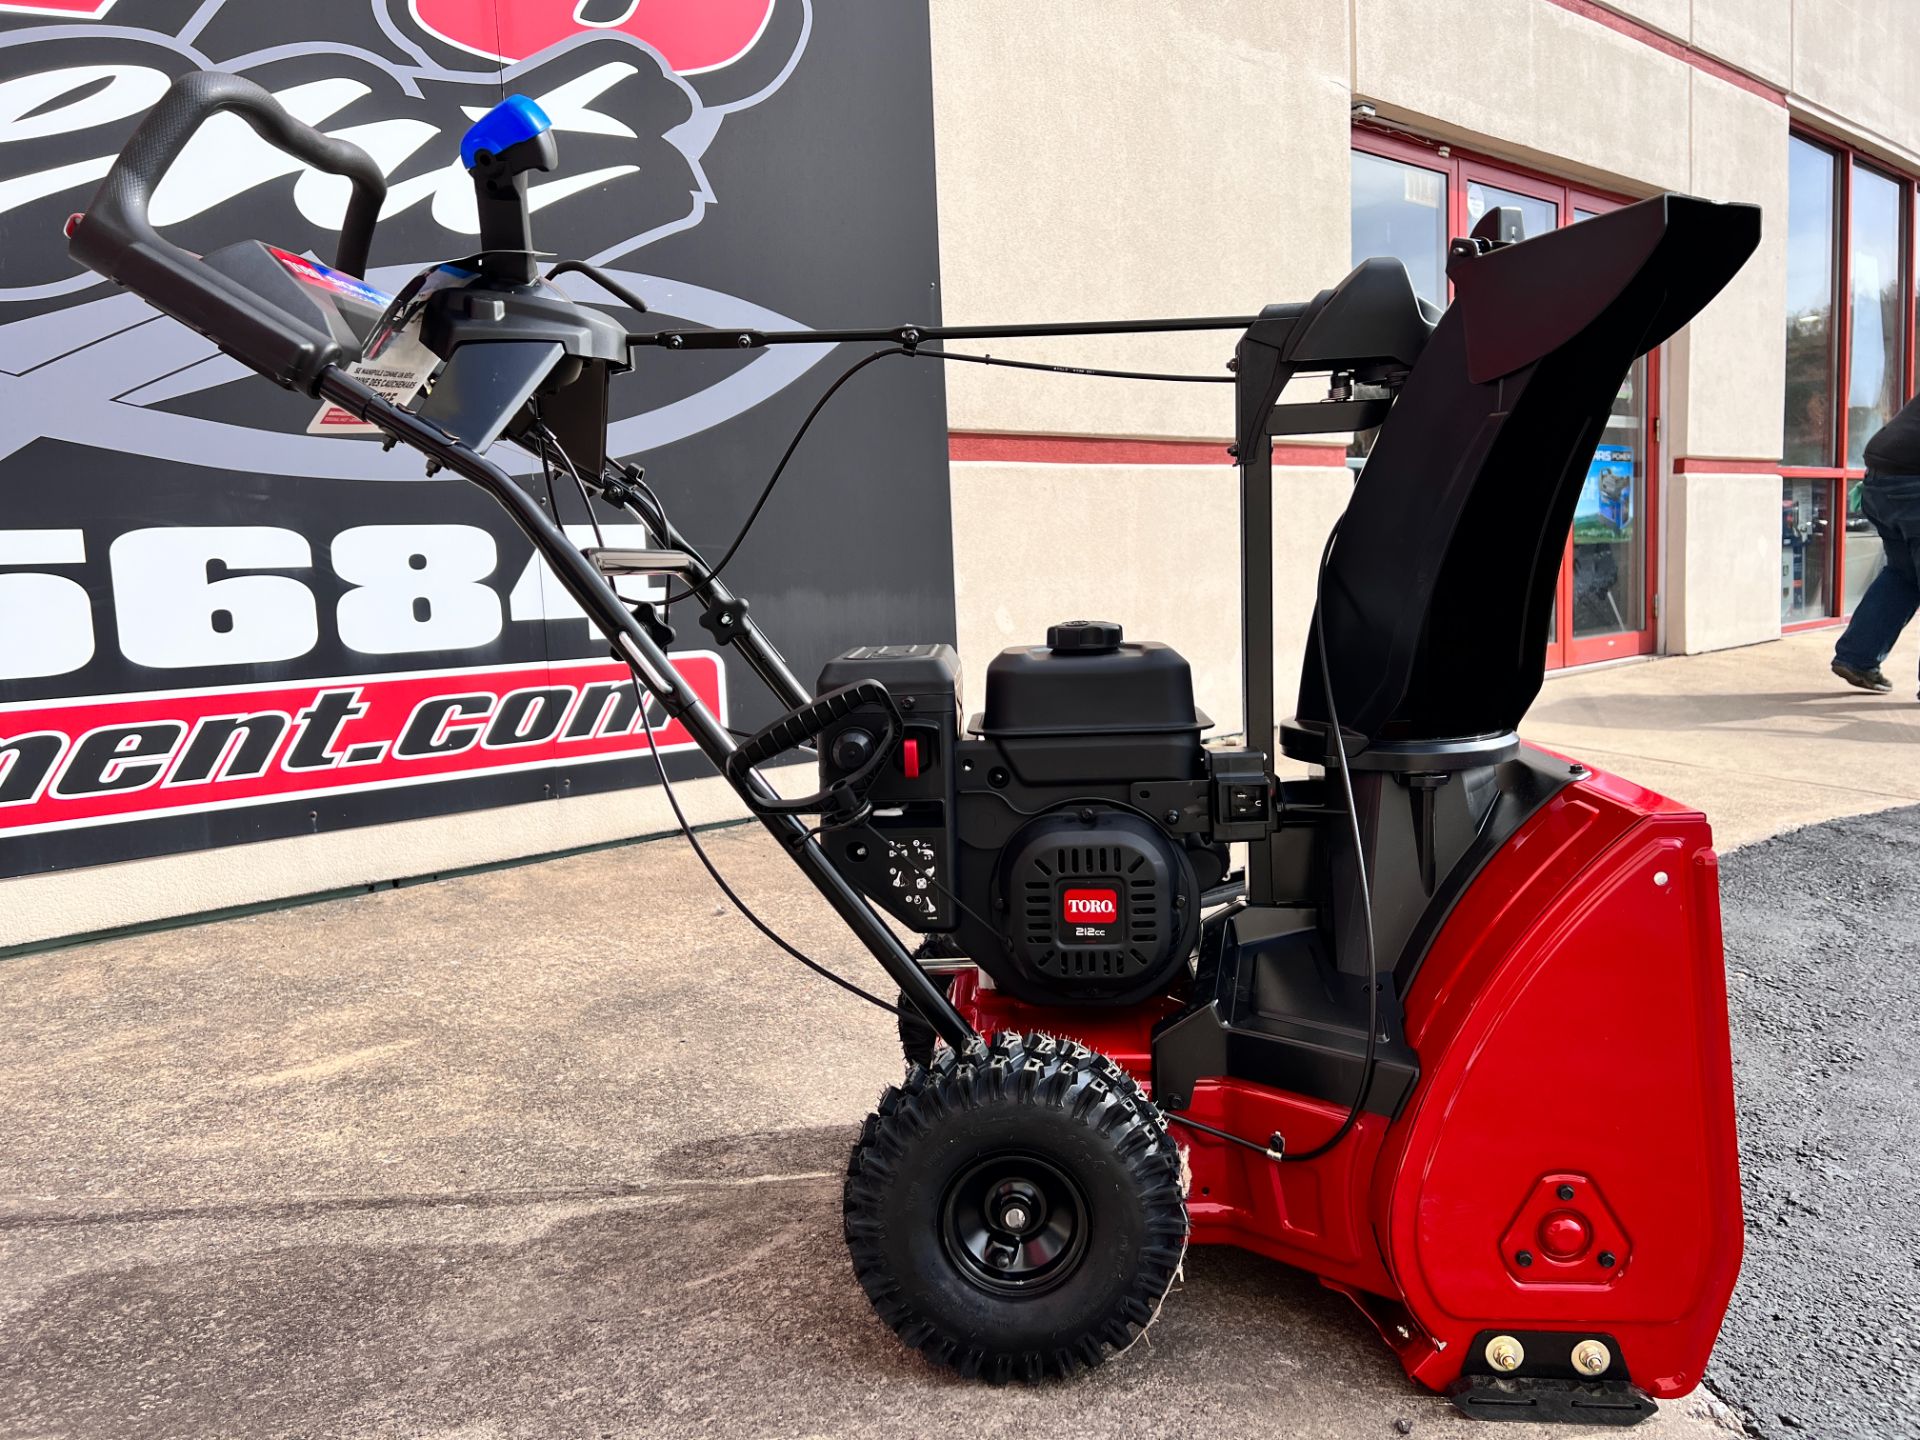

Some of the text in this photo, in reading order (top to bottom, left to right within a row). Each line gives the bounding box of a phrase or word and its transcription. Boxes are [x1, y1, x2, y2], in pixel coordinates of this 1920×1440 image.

[368, 378, 382, 387] DES
[1068, 899, 1113, 913] TORO
[1075, 927, 1106, 936] 212cc
